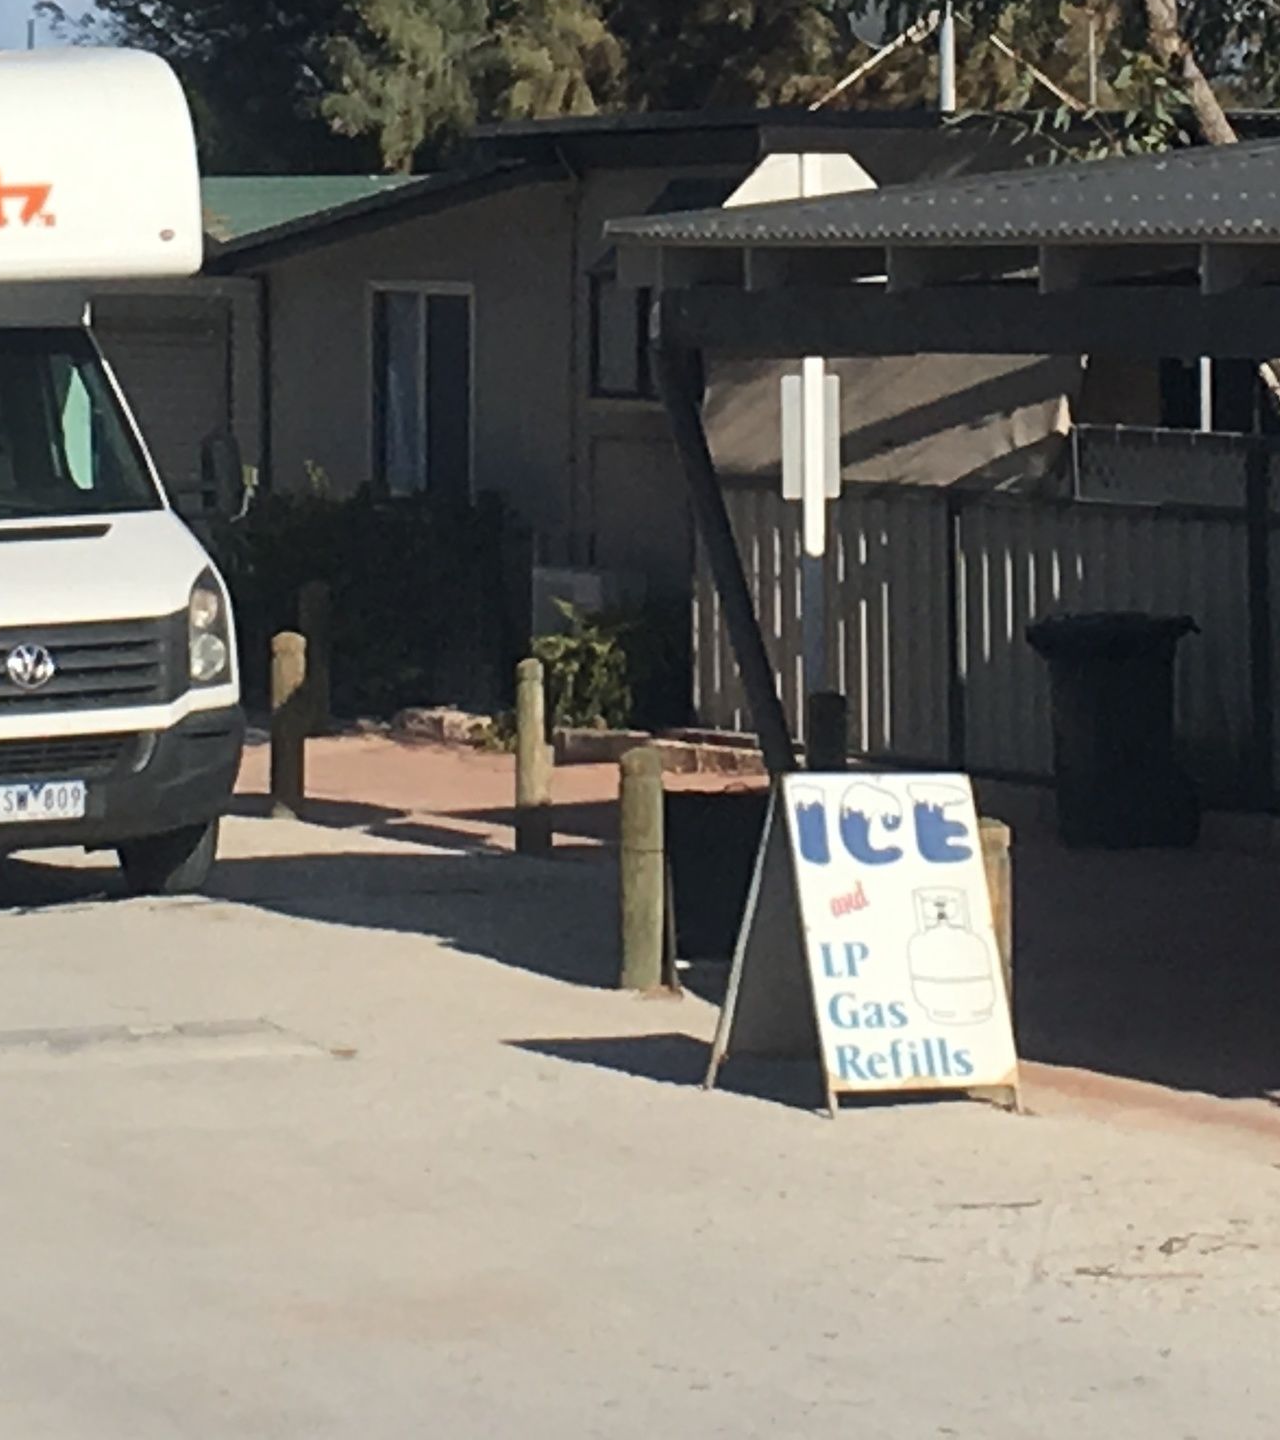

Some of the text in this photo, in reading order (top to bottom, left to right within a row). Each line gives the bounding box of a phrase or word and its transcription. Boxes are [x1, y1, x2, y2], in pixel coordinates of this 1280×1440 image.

[790, 782, 973, 866] ICE
[830, 880, 869, 919] and
[819, 941, 869, 978] LP
[828, 992, 909, 1030] Gas
[834, 1037, 974, 1081] Refills
